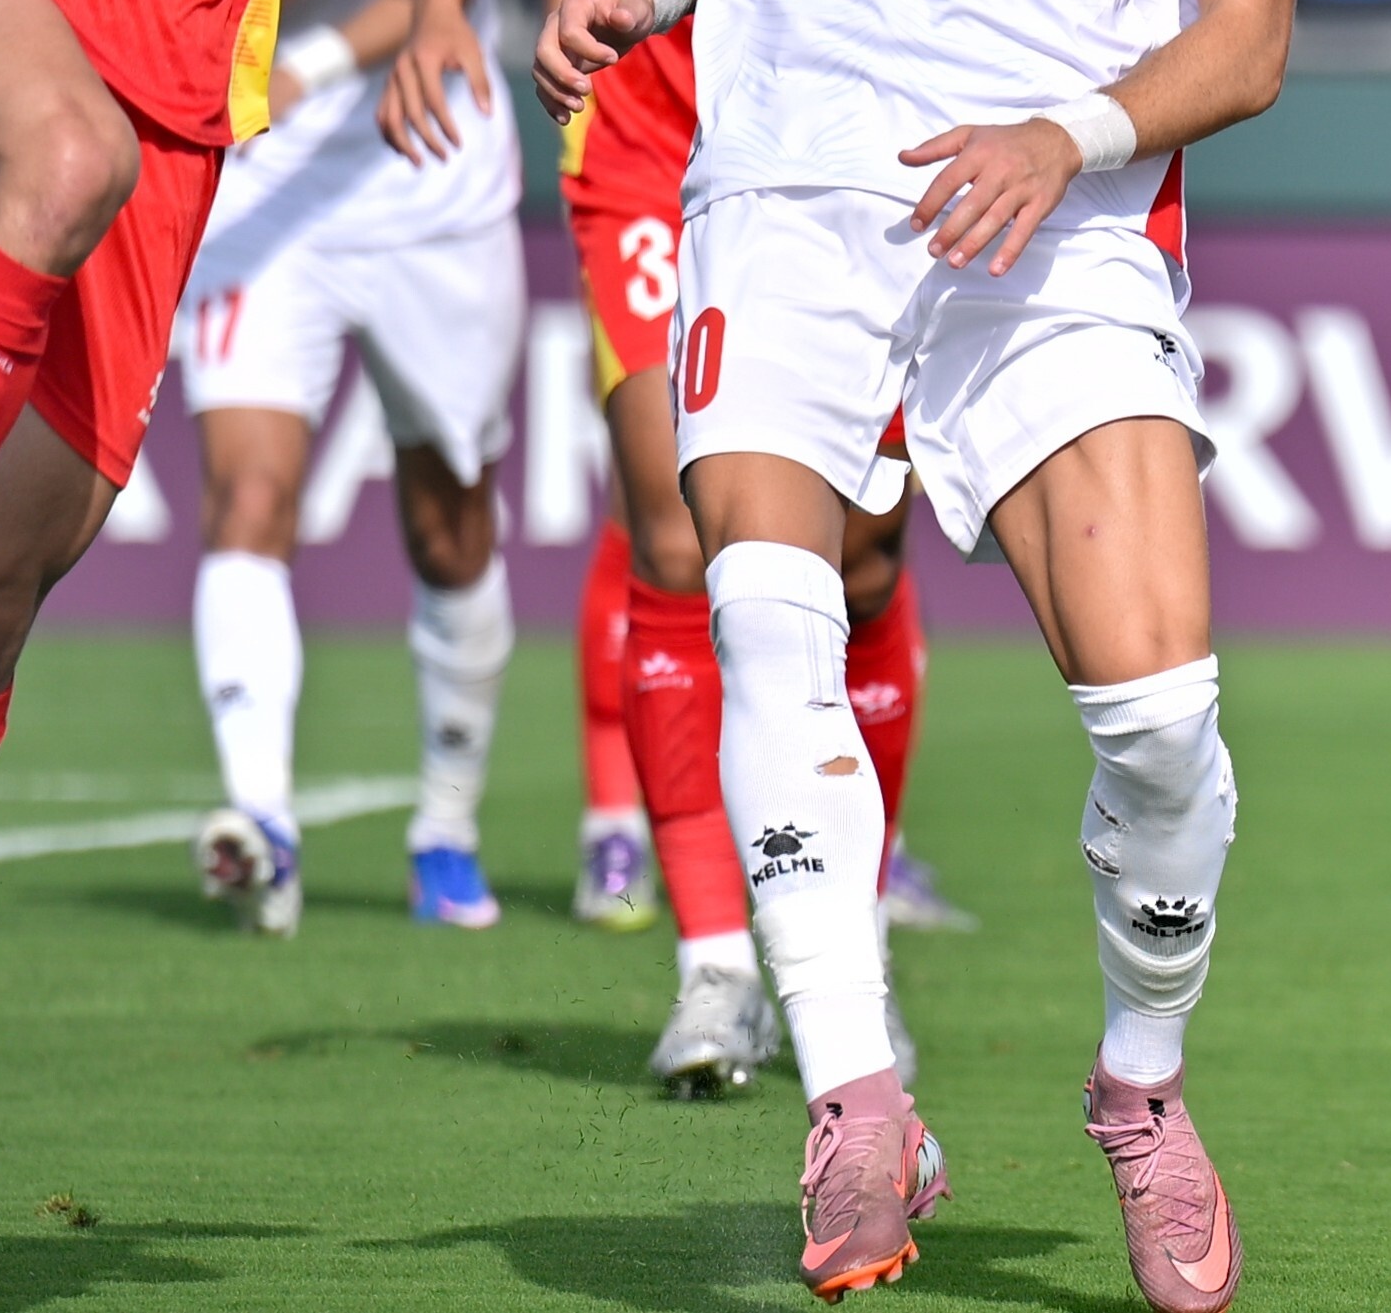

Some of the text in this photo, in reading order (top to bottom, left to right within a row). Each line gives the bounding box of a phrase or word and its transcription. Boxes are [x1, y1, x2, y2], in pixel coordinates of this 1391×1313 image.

[619, 216, 679, 323] 3
[195, 287, 245, 365] 17
[673, 306, 726, 418] 0
[751, 856, 825, 888] KELME
[1132, 919, 1205, 937] KELME
